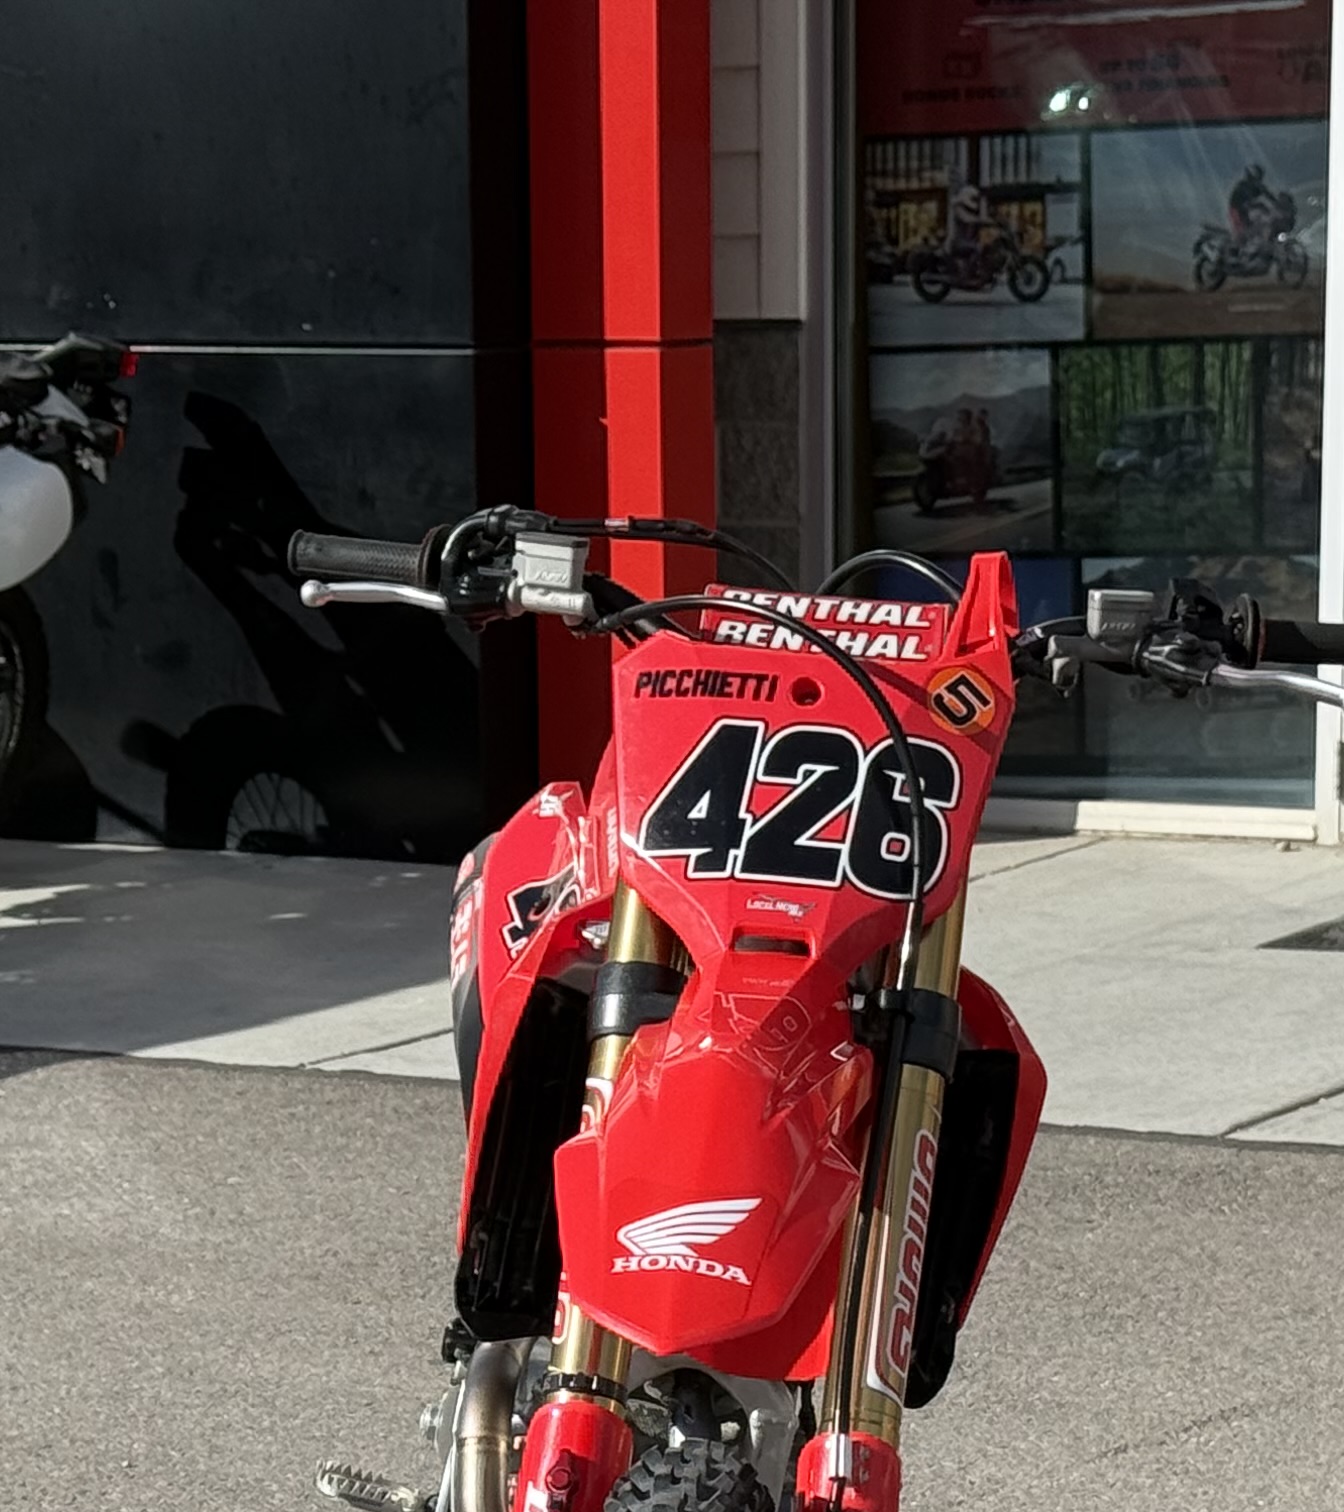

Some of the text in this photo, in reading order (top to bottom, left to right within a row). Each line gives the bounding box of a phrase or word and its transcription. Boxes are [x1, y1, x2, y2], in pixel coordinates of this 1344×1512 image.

[634, 669, 779, 702] PICCHIETTI
[930, 671, 993, 729] 5
[638, 717, 960, 900] 426
[611, 1255, 752, 1286] HONDA
